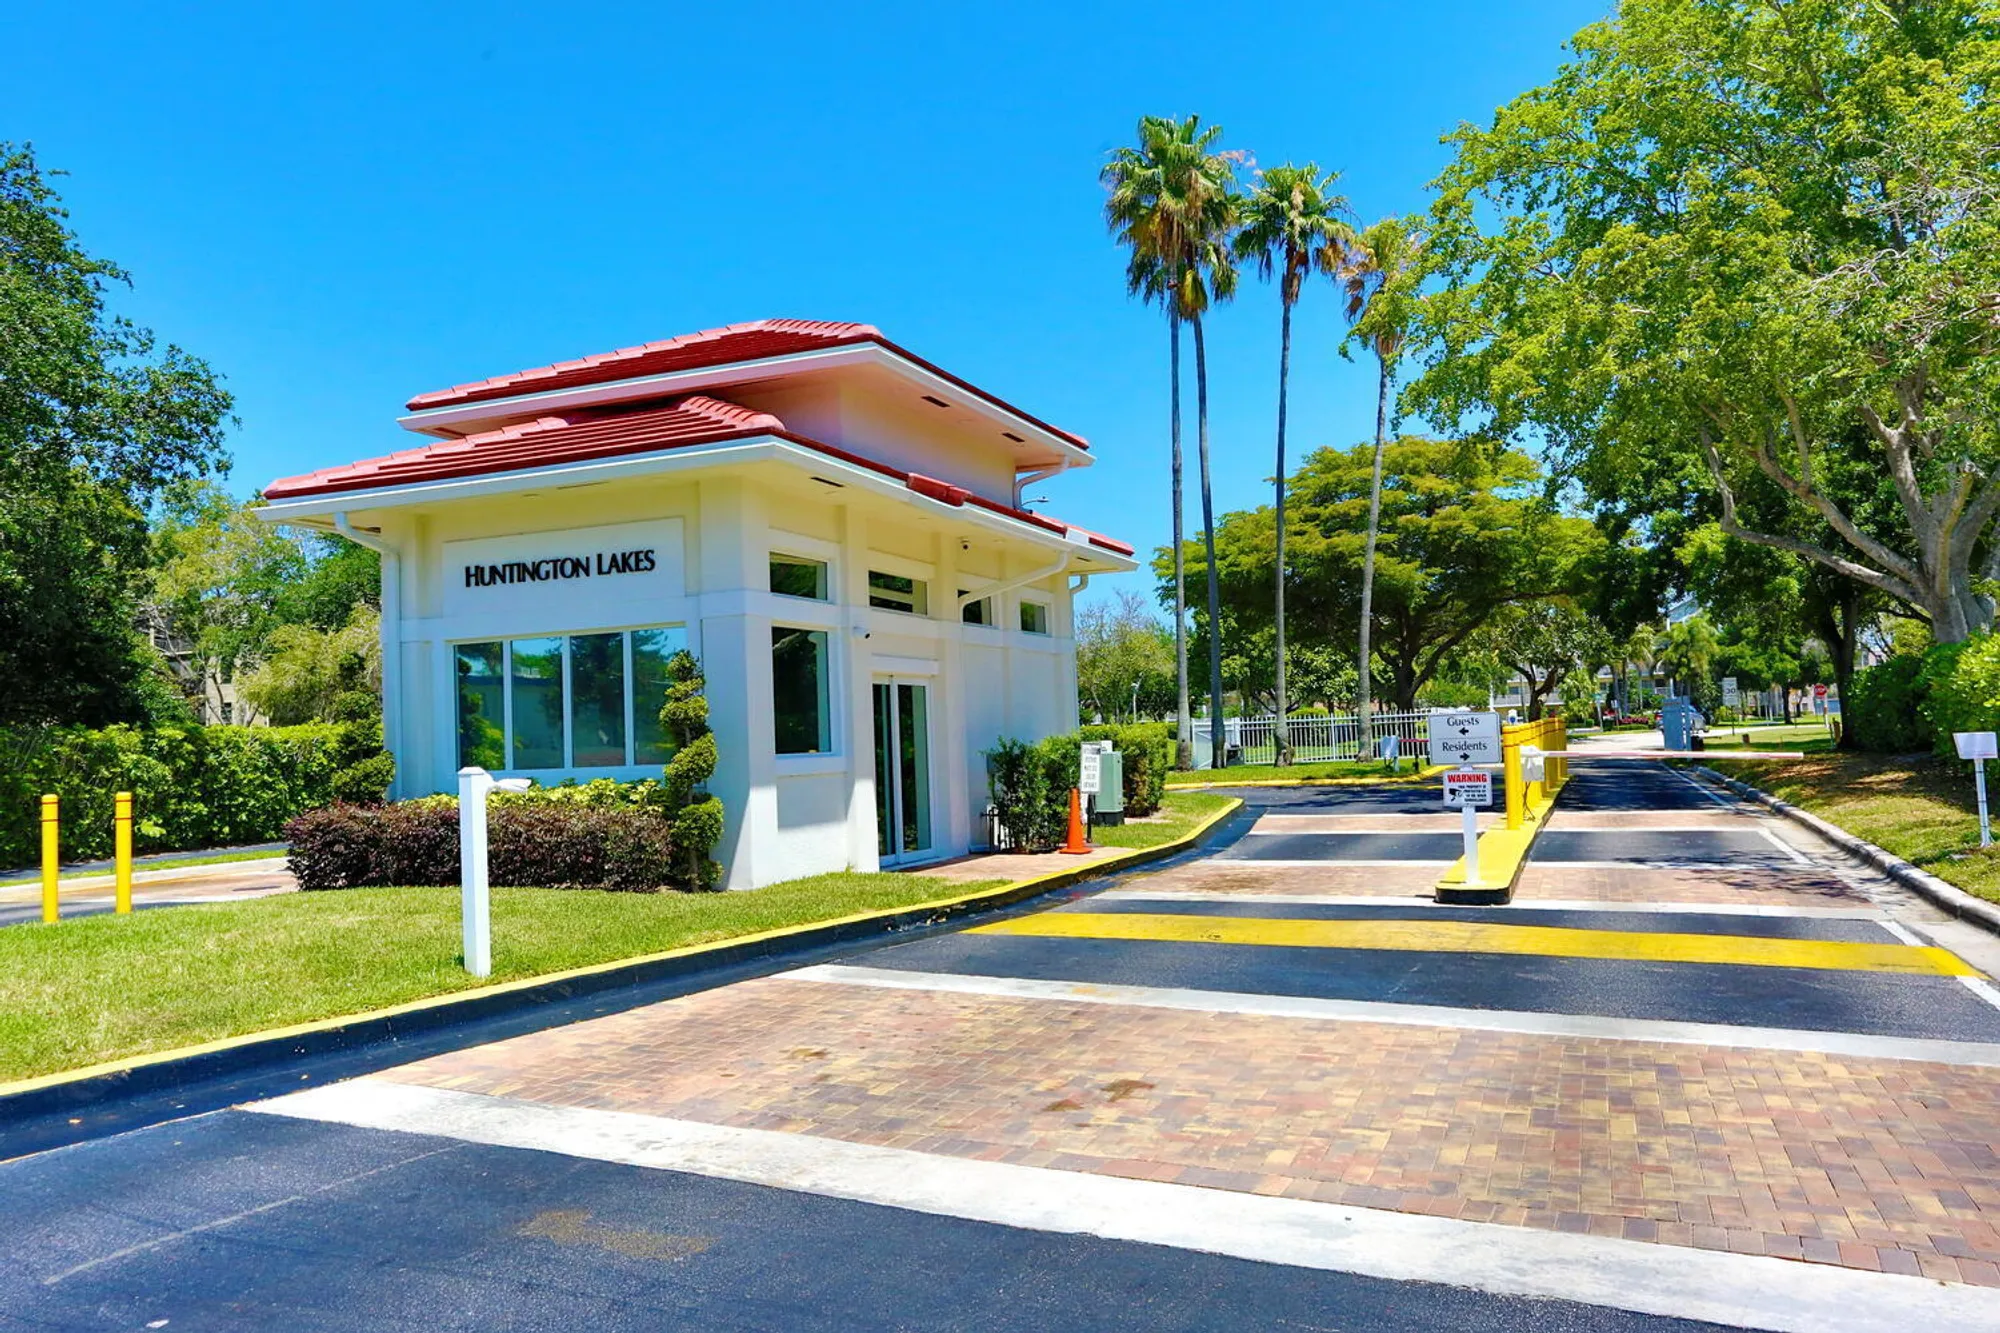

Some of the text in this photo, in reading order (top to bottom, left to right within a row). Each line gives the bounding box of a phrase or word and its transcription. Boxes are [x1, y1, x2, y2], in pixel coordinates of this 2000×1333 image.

[465, 549, 655, 587] HUNTINGTON LAKES
[1446, 716, 1480, 727] Guests
[1442, 741, 1488, 752] Residents
[1447, 773, 1487, 783] WARNING
